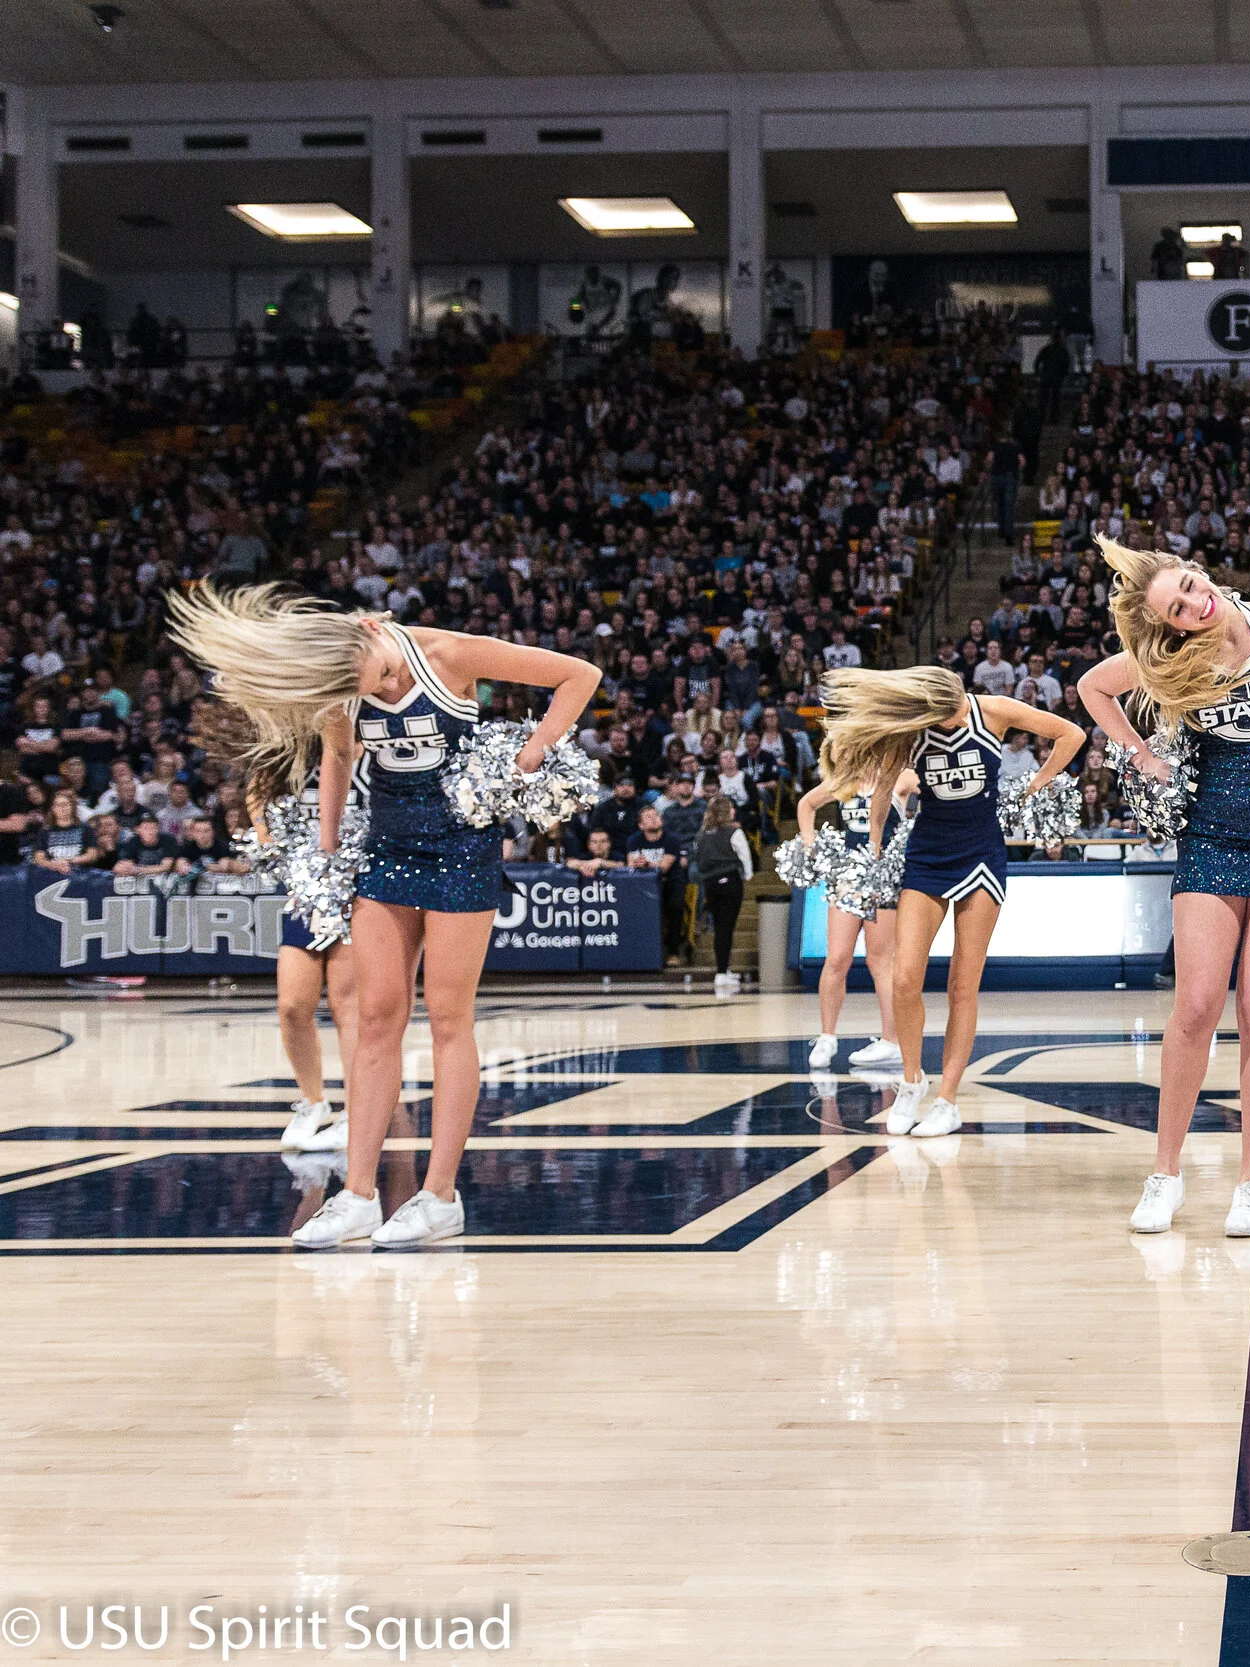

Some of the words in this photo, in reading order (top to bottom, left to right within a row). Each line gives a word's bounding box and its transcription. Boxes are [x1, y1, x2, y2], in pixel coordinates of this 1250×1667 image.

[738, 261, 752, 277] K
[1101, 257, 1113, 273] L
[924, 763, 987, 787] STATE
[530, 880, 618, 905] Credit
[532, 905, 620, 929] Union
